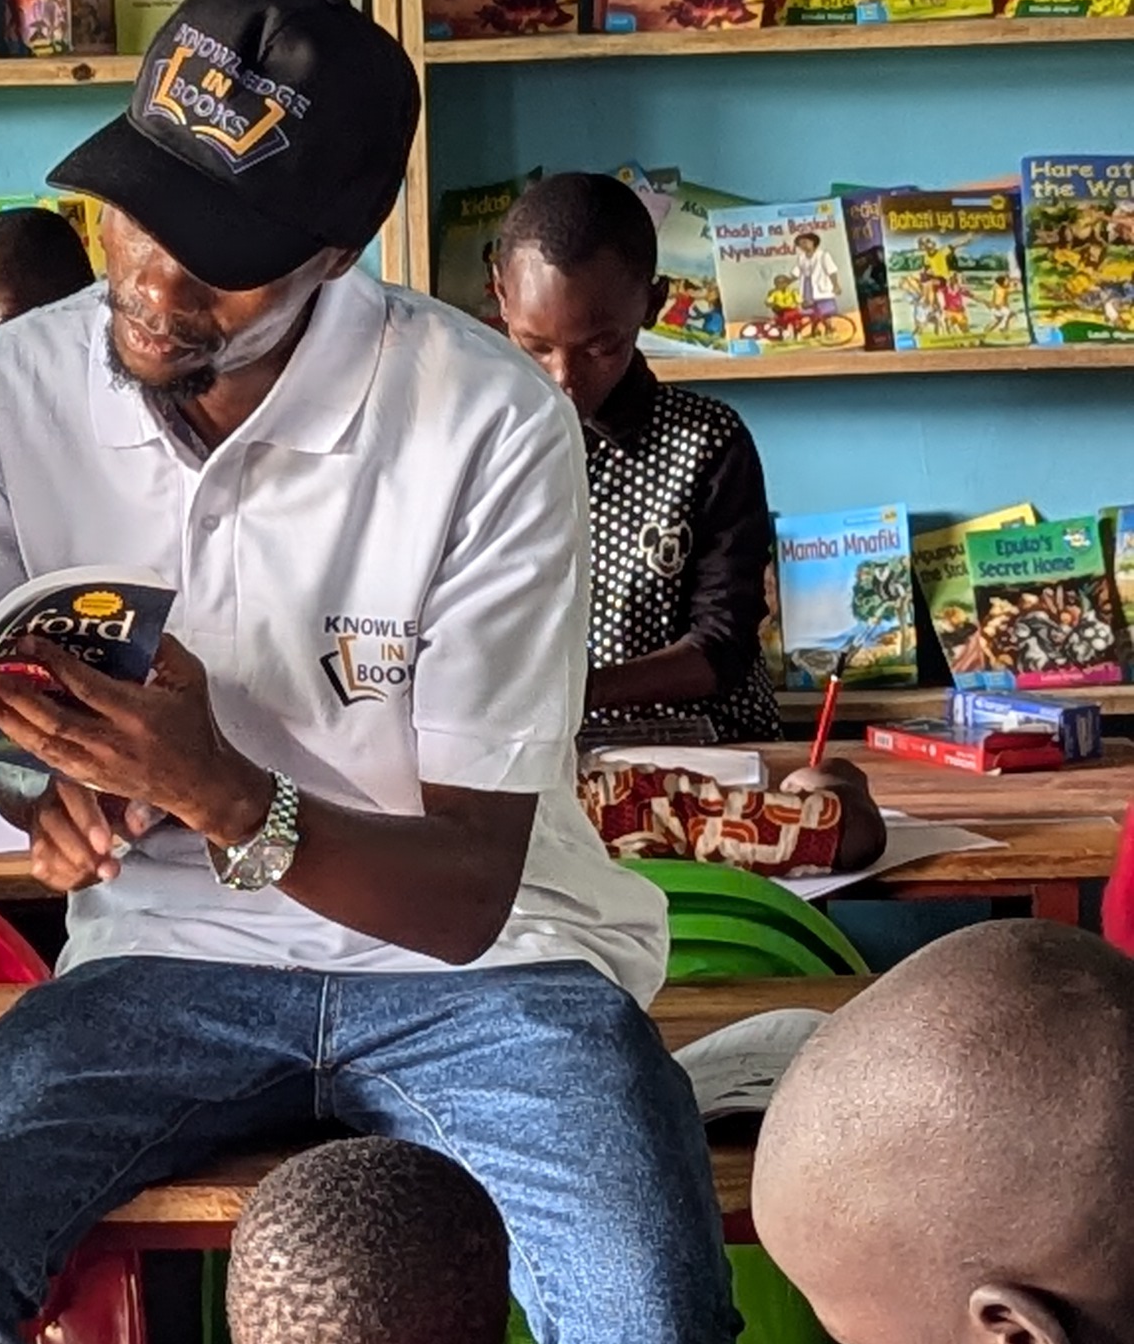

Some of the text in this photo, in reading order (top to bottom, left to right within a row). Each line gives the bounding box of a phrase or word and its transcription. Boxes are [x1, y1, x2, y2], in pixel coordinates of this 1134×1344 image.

[174, 22, 312, 120] KNOWLEDGE
[201, 68, 233, 99] IN
[169, 77, 251, 138] BOOKS
[1030, 160, 1134, 180] Hare at
[1031, 179, 1134, 198] the Wel
[716, 223, 765, 242] Khadija
[768, 223, 784, 236] na
[787, 217, 836, 235] Baiskeli
[888, 209, 934, 231] Bahati
[935, 212, 955, 234] ya
[719, 243, 797, 263] Nyekundu
[780, 527, 902, 564] Mamba Mnafiki
[979, 561, 1030, 578] Secret
[1033, 556, 1076, 572] Home
[324, 615, 419, 638] KNOWLE
[381, 643, 405, 662] IN
[357, 664, 415, 686] BOO
